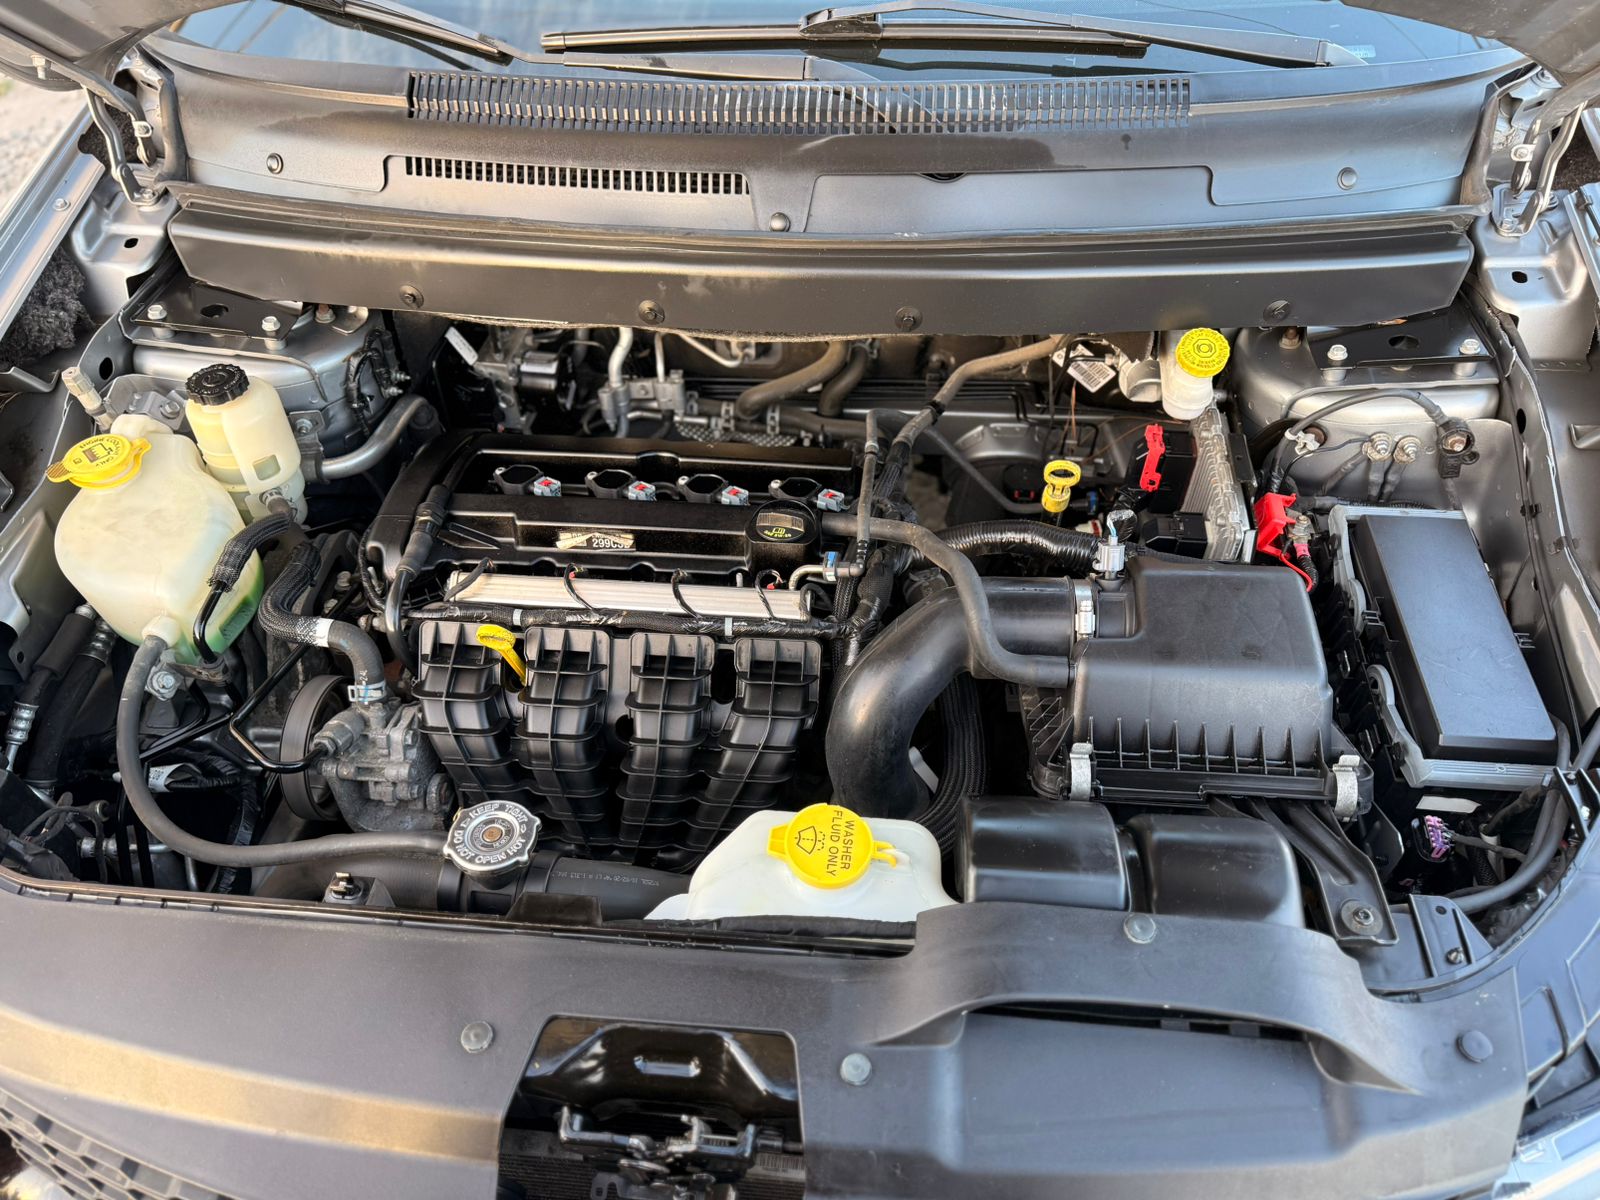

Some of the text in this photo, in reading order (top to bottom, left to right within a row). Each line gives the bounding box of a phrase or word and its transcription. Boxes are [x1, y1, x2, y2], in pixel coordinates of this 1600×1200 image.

[469, 803, 529, 822] KEEP TIGHT
[453, 829, 465, 844] DO
[506, 836, 526, 855] HOT
[826, 810, 843, 877] FLUID ONLY
[840, 820, 855, 870] WASHER
[455, 844, 476, 860] NOT
[475, 852, 507, 864] OPEN
